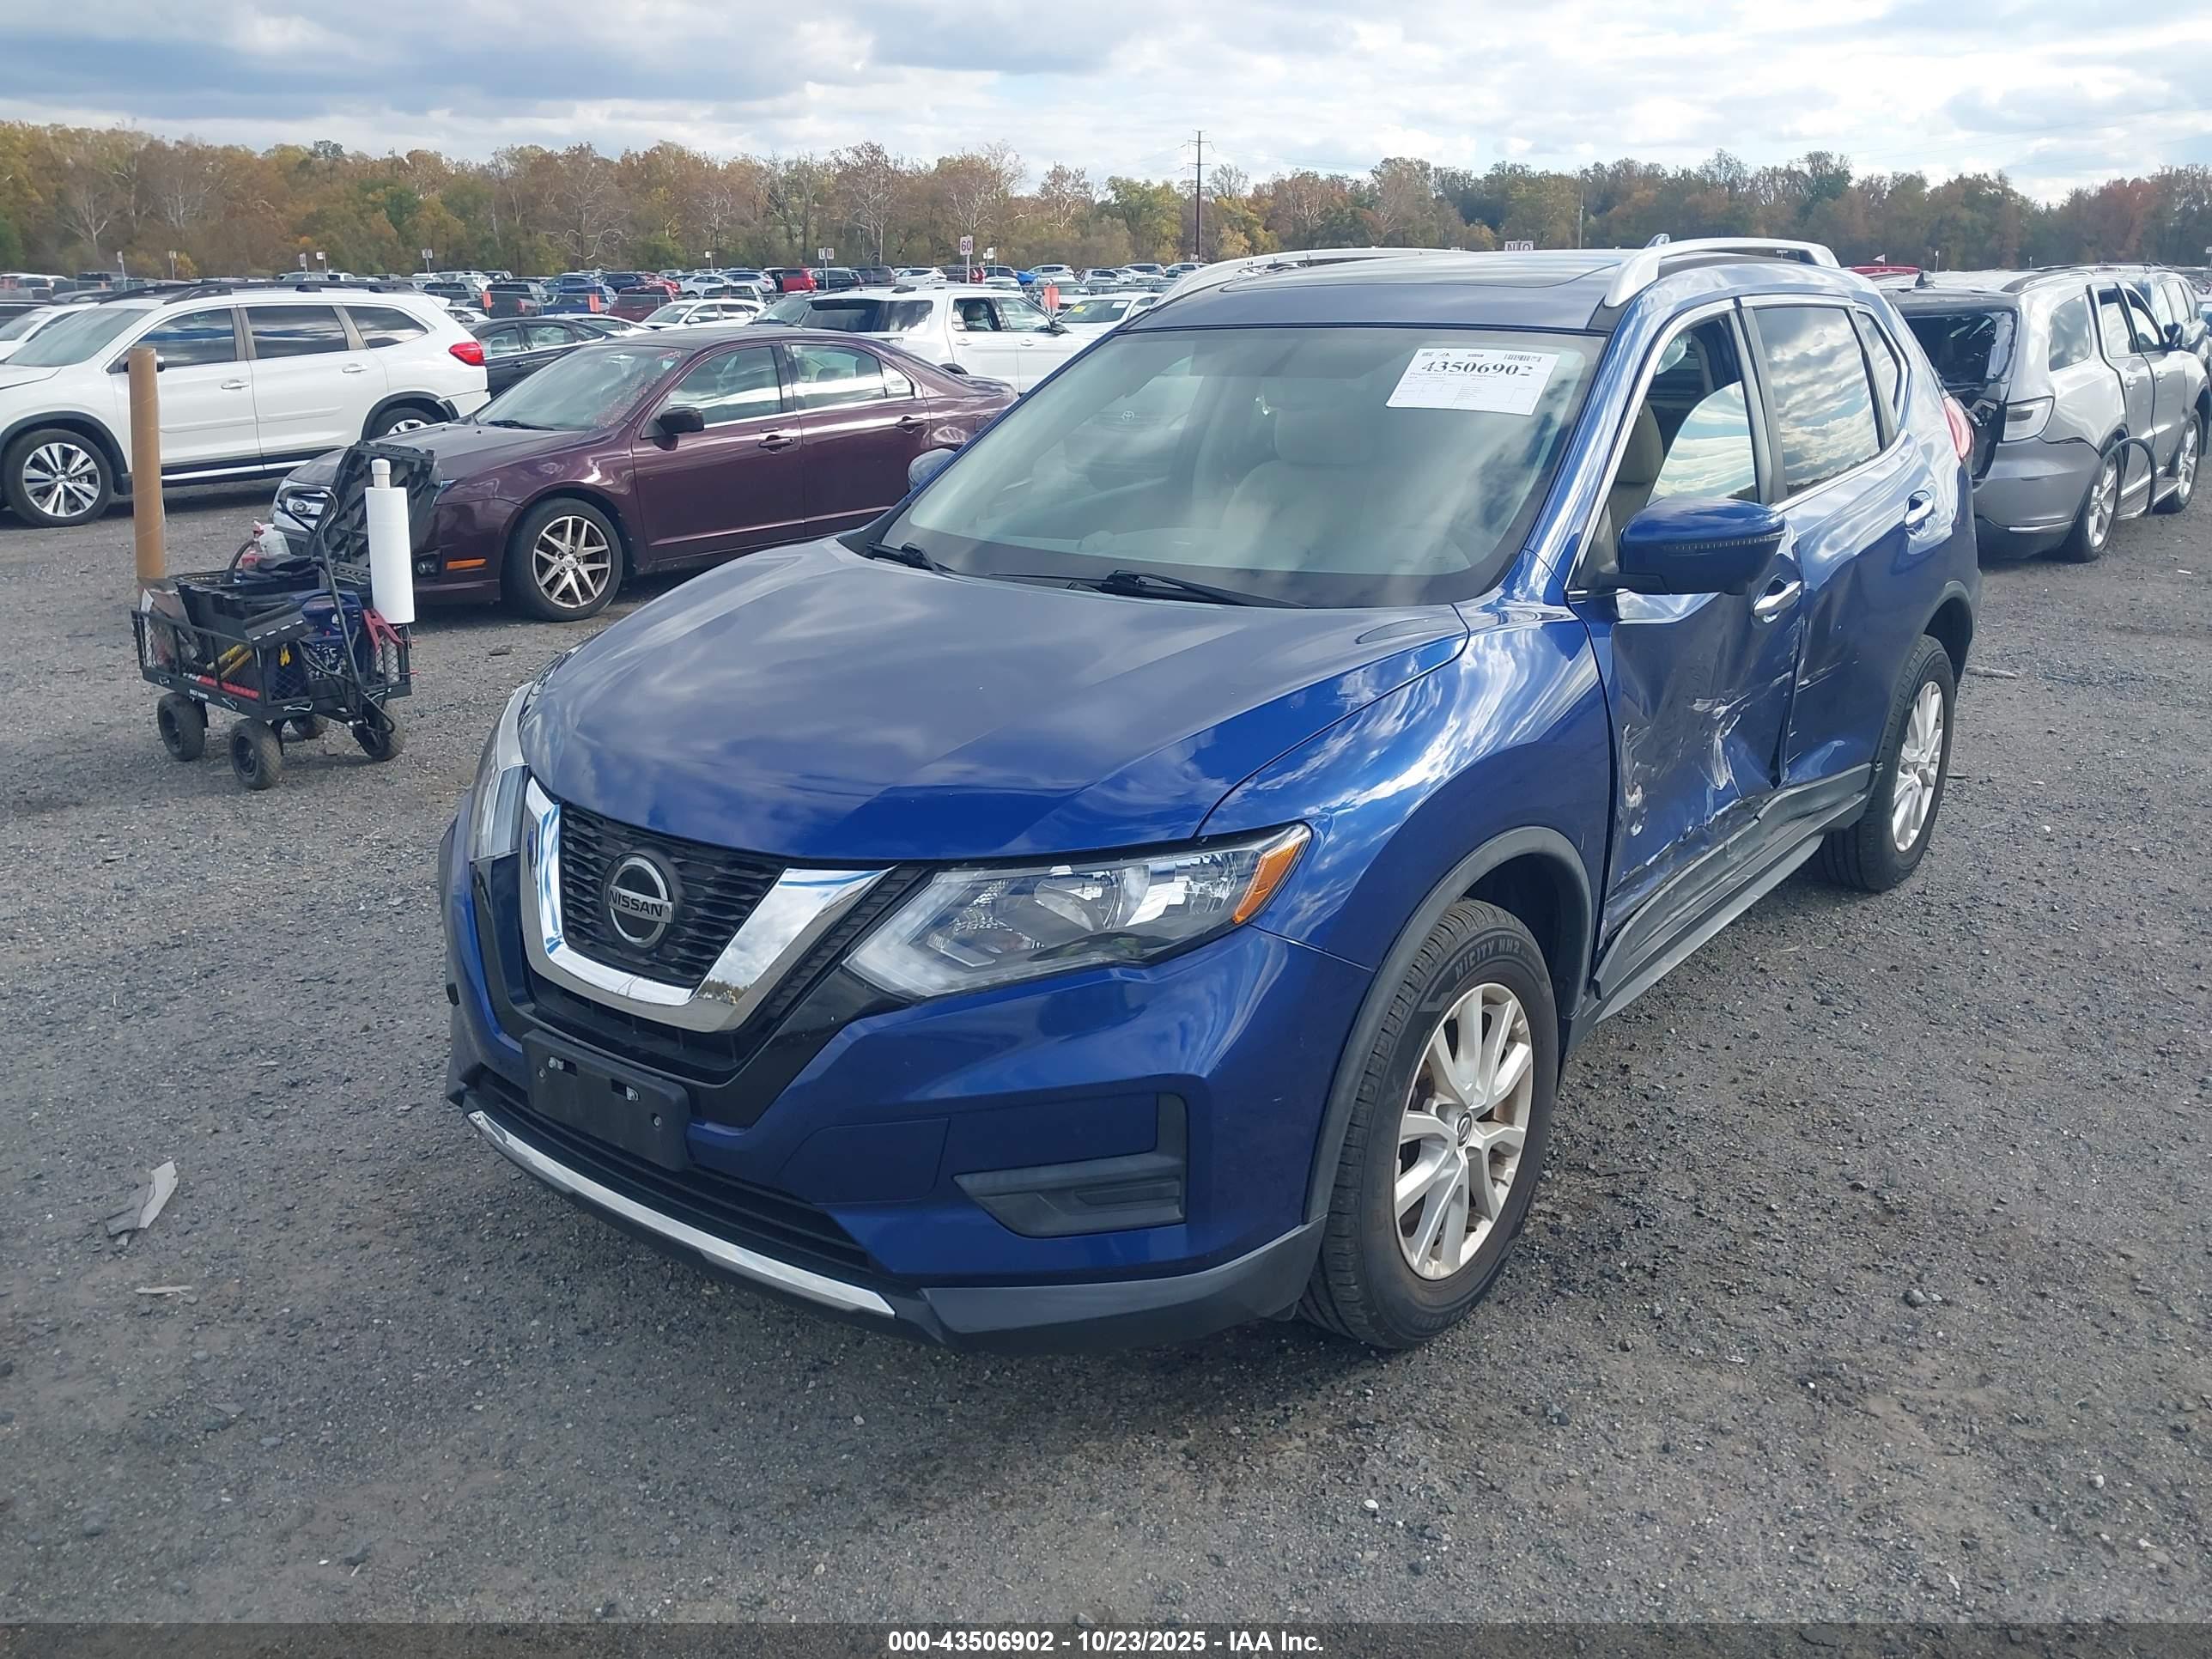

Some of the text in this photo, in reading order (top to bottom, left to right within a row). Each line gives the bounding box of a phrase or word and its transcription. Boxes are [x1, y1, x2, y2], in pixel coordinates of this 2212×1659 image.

[961, 240, 972, 252] 60
[1421, 361, 1534, 376] 43506902
[609, 890, 663, 917] NISSAN
[1455, 938, 1521, 980] HICITY HH2
